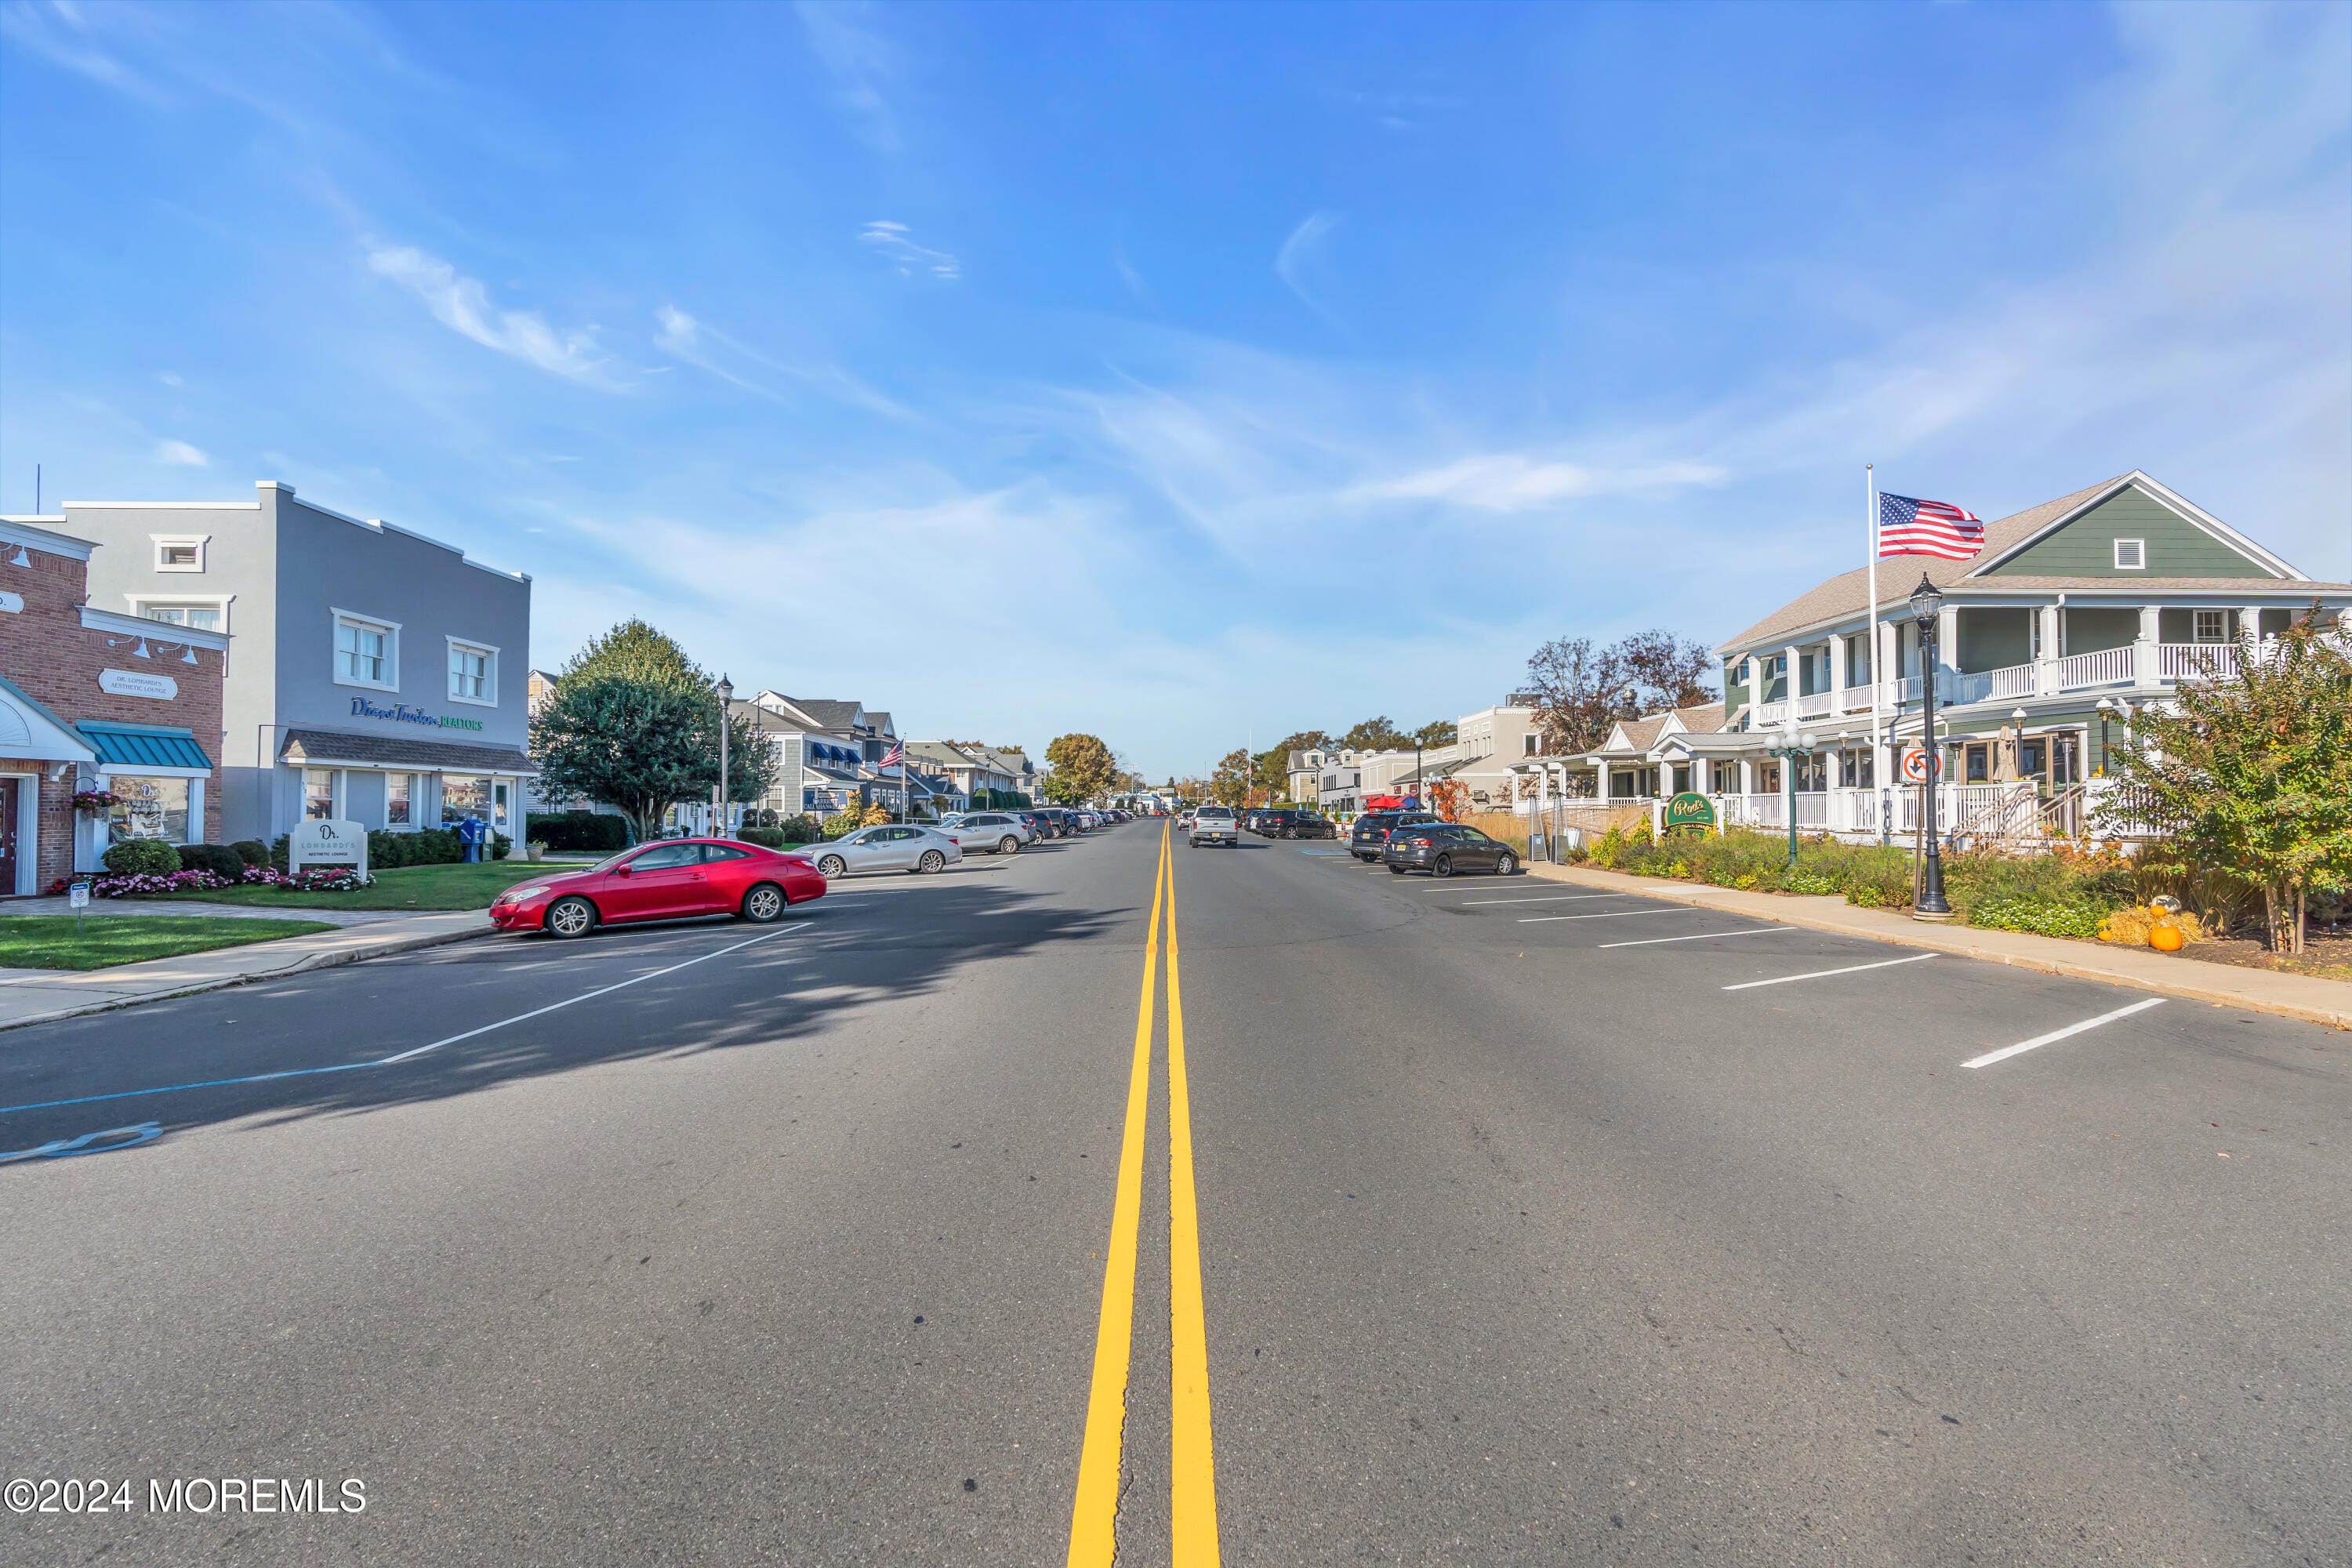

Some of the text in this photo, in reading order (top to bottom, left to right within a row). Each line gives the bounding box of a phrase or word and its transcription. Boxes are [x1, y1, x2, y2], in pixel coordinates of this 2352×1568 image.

[111, 682, 167, 695] AESTHETIC LOUNGE
[128, 677, 162, 687] LOMBARDI'S
[350, 695, 394, 720] Diane
[441, 715, 484, 731] REALTORS
[1673, 799, 1708, 817] Rod's
[320, 825, 339, 840] Dr.
